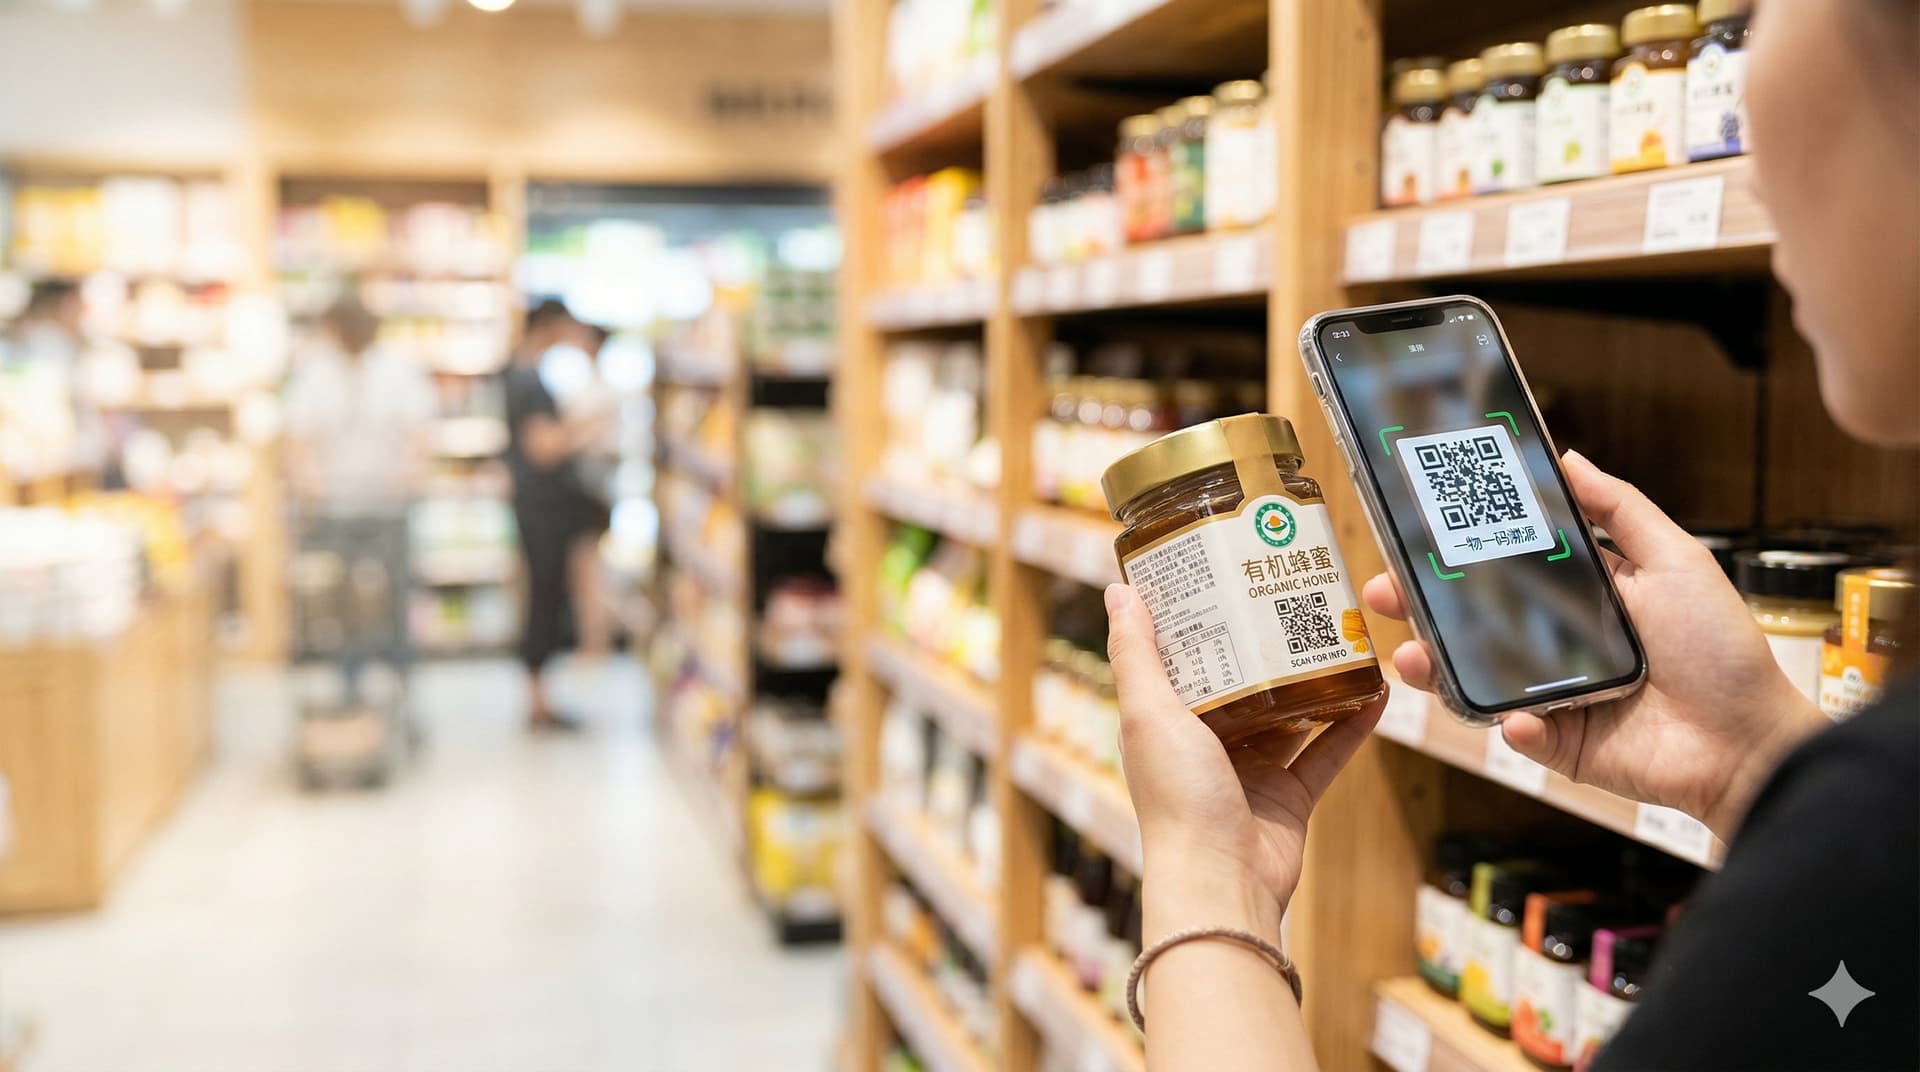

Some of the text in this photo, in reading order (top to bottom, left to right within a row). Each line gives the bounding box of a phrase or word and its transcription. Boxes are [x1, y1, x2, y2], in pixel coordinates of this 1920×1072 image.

[1241, 545, 1334, 584] 有机蜂蜜
[1248, 572, 1341, 598] ORGANIC HONEY
[1291, 649, 1347, 668] SCAN FOR INFO
